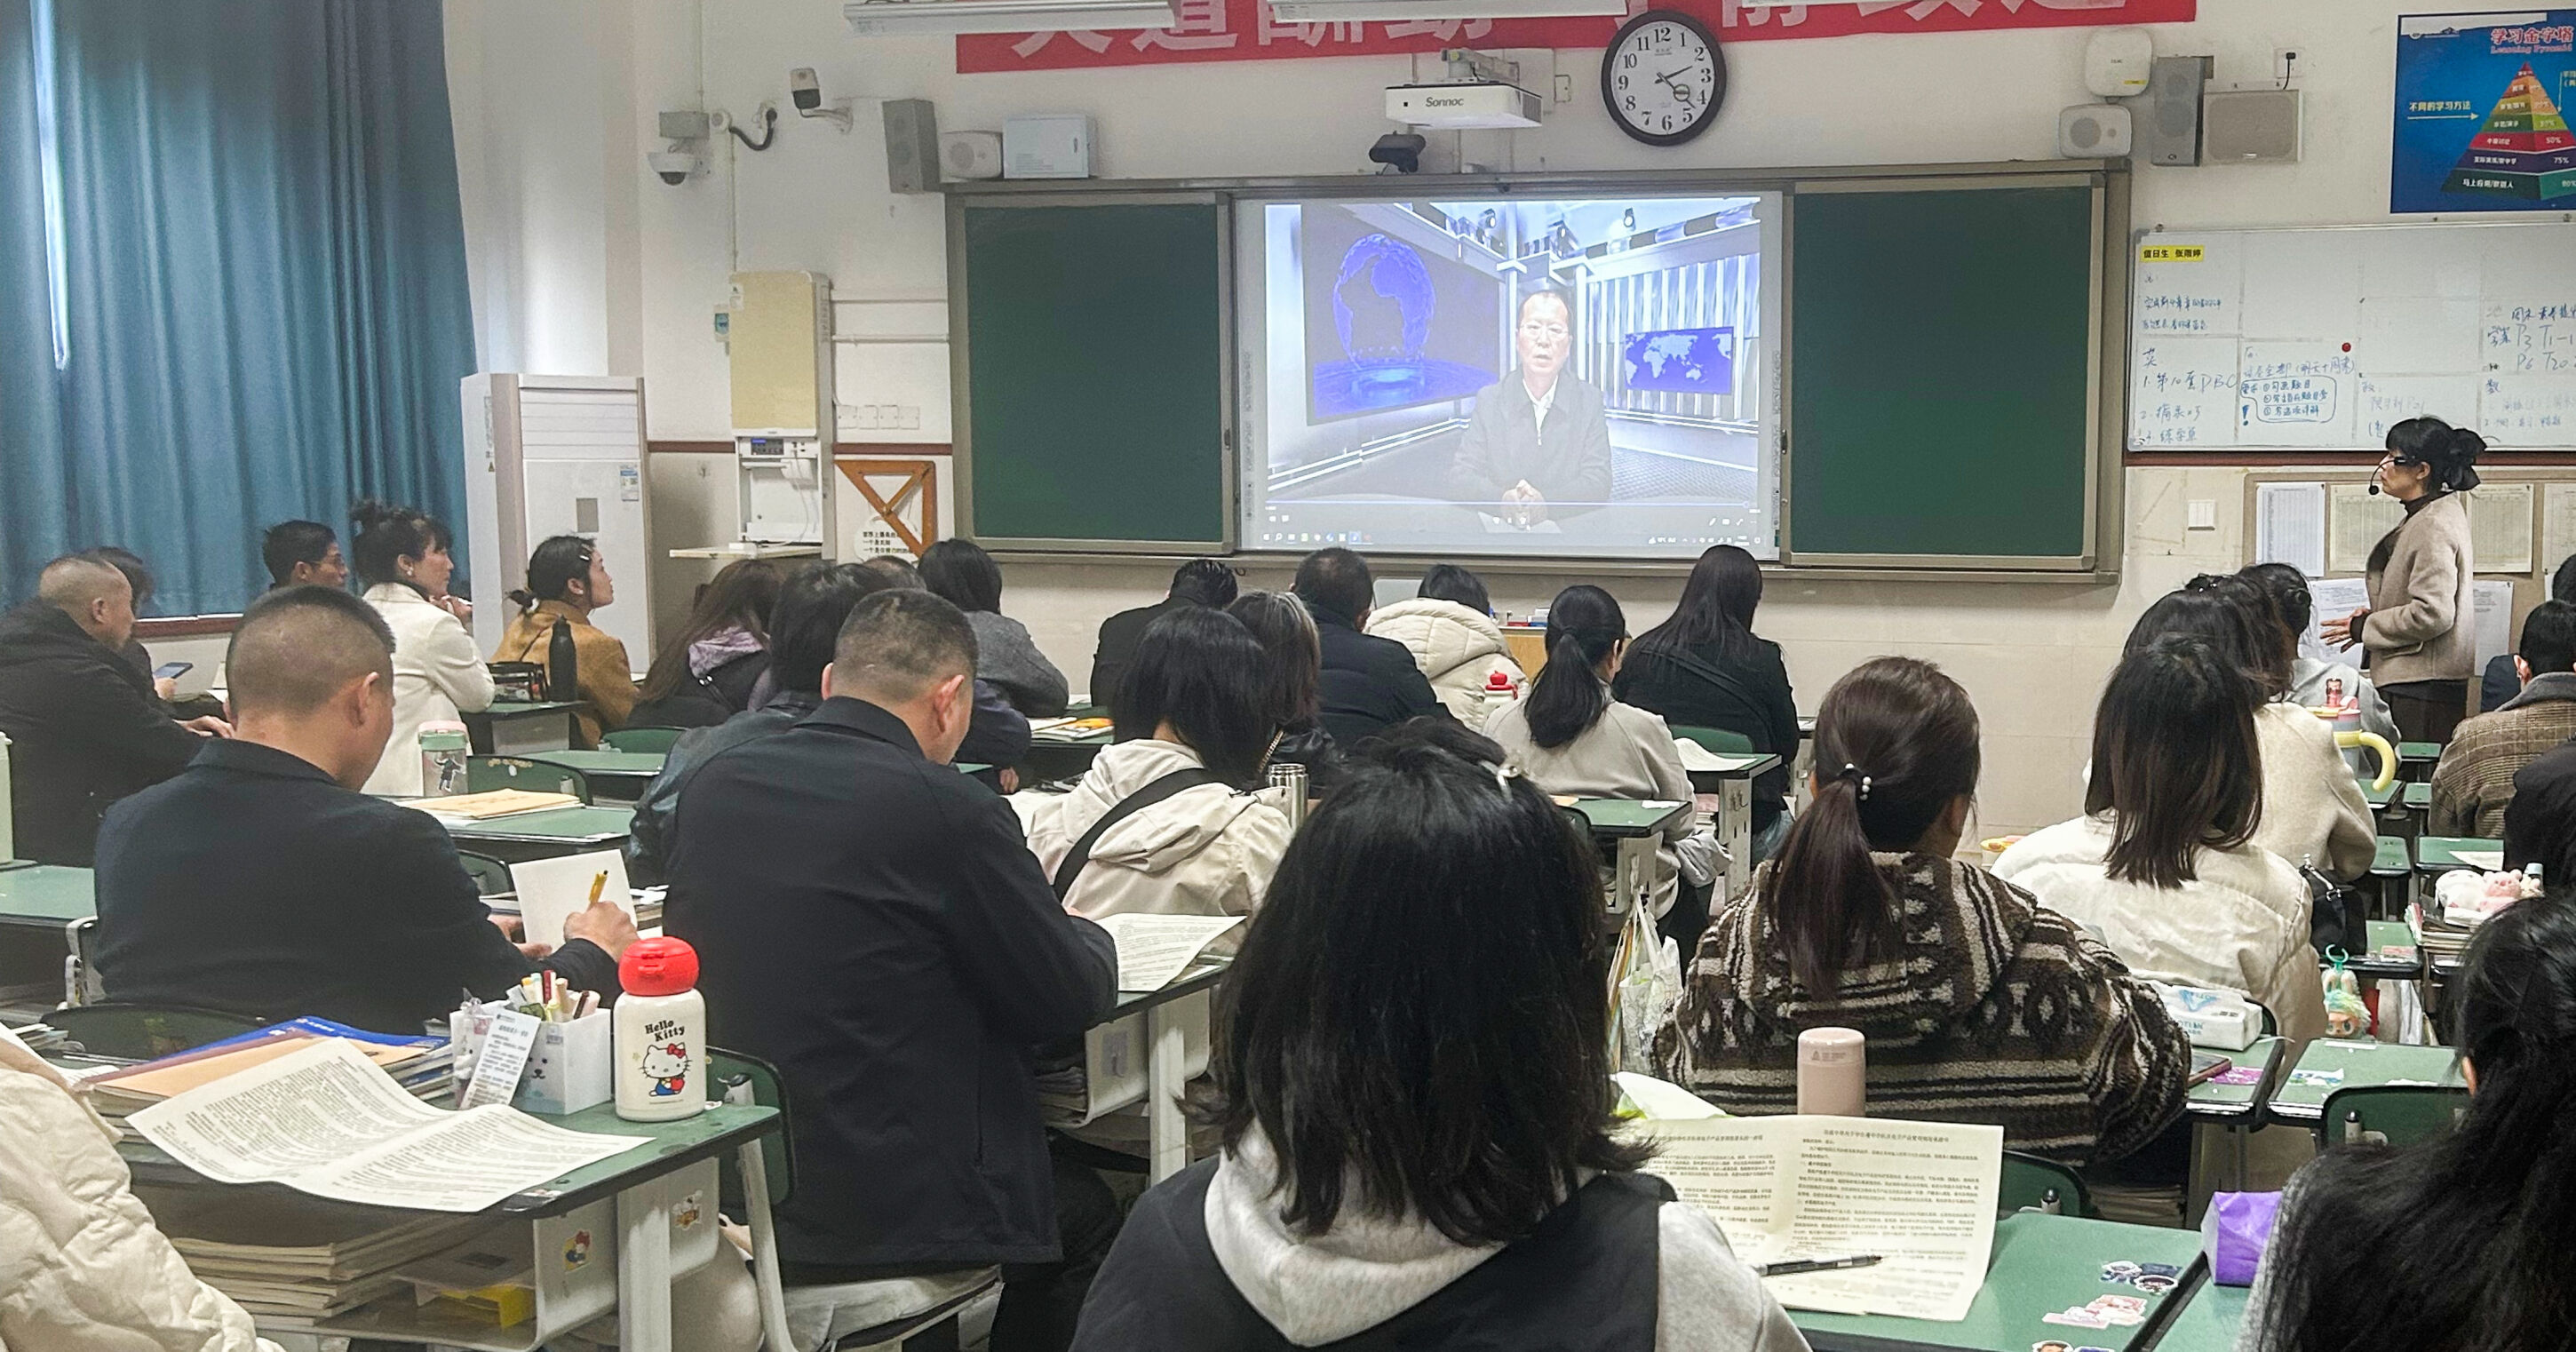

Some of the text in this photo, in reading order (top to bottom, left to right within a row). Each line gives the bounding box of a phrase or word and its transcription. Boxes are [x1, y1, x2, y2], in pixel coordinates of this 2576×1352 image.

[1654, 27, 1671, 43] 12
[1680, 32, 1686, 47] 1
[2491, 26, 2574, 44] 学习金字塔
[1636, 36, 1650, 51] 11
[1624, 52, 1637, 68] 10
[1694, 46, 1705, 61] 2
[1618, 75, 1629, 90] 9
[1700, 68, 1712, 83] 3
[1425, 97, 1465, 107] Sonnoc
[1626, 95, 1636, 111] 8
[1697, 89, 1706, 105] 4
[2409, 100, 2471, 111] 不同的学习方法
[1642, 110, 1651, 125] 7
[1682, 107, 1693, 123] 5
[1661, 115, 1672, 131] 6
[645, 1019, 674, 1034] Hello
[654, 1025, 685, 1042] Kitty
